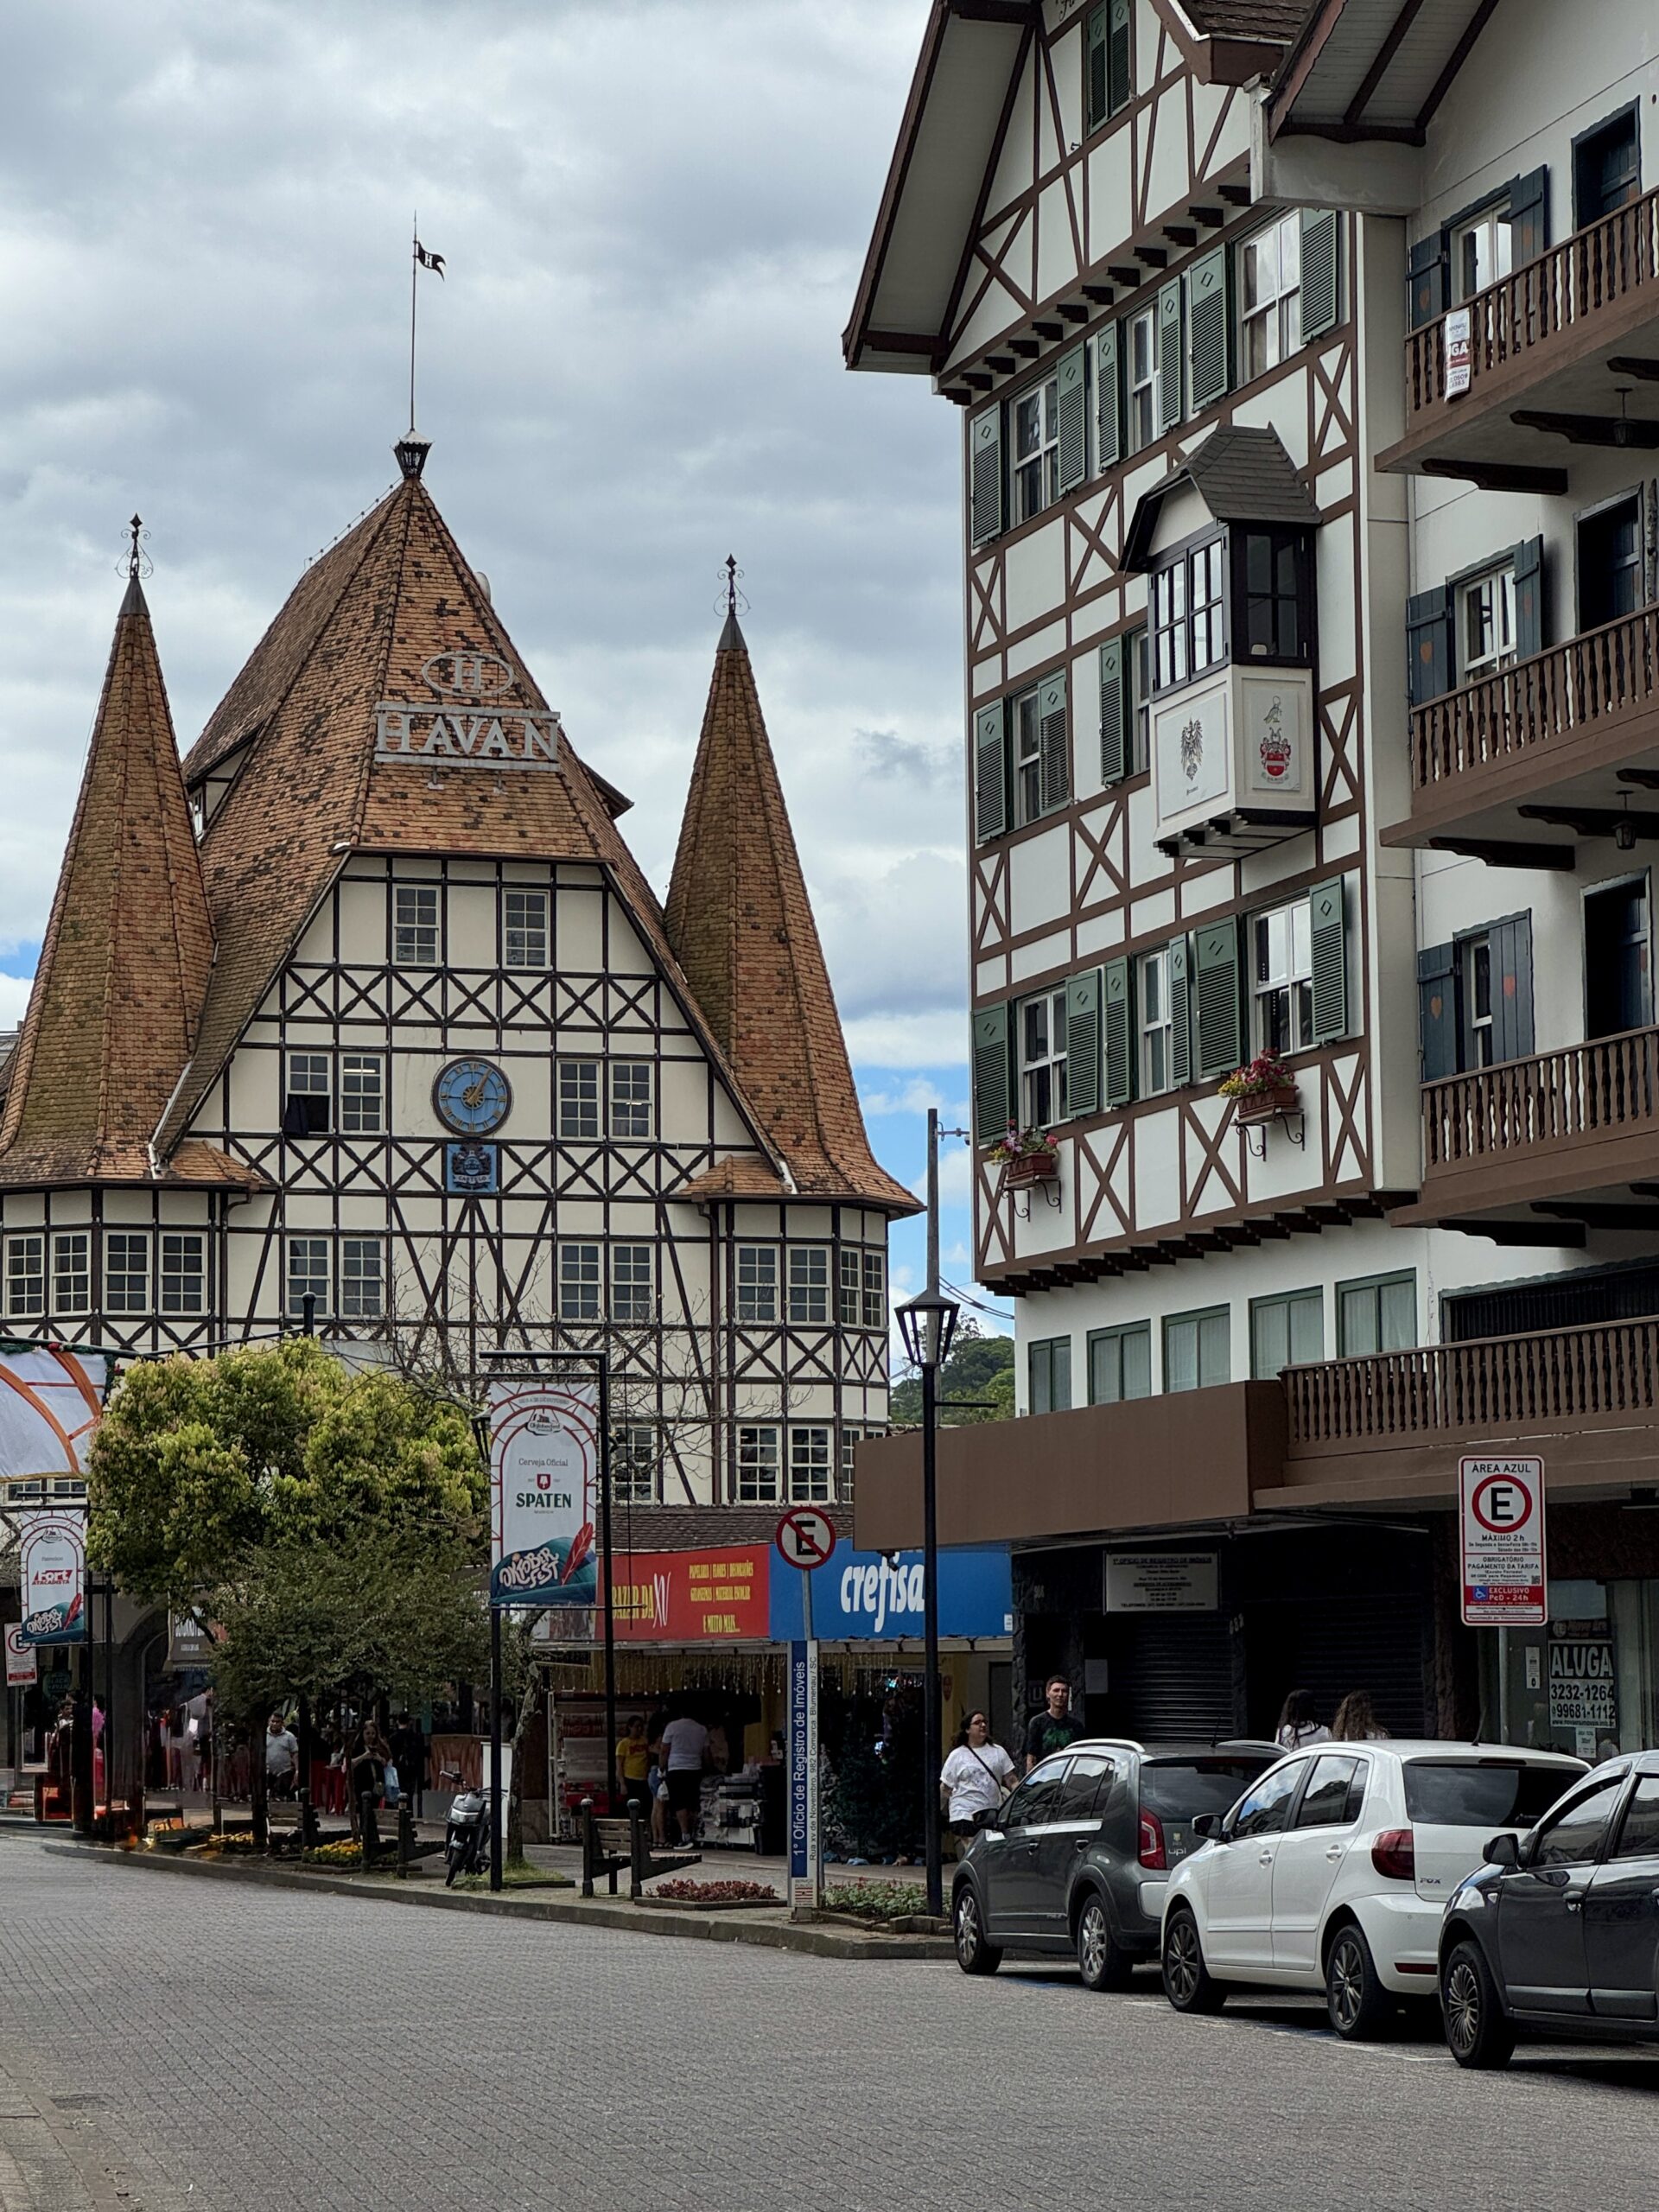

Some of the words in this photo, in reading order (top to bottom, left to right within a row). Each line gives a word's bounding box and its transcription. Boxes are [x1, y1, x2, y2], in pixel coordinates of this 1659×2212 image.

[424, 252, 433, 268] H
[453, 657, 486, 690] H
[375, 712, 560, 762] HAVAN
[518, 1458, 545, 1467] Cerveja
[1471, 1461, 1501, 1472] ÁREA
[1503, 1464, 1532, 1472] AZUL
[516, 1492, 572, 1508] SPATEN
[1491, 1487, 1514, 1521] E
[796, 1520, 817, 1555] E
[1482, 1532, 1511, 1541] MÁXIMO
[641, 1585, 655, 1618] DA
[652, 1572, 671, 1629] XV
[841, 1552, 925, 1633] crefisa
[810, 1656, 816, 1669] SC
[1551, 1646, 1614, 1677] ALUGA
[793, 1661, 804, 1707] Imóveis
[1551, 1684, 1615, 1701] 3232-1264
[793, 1712, 804, 1727] de
[793, 1730, 807, 1780] Registro
[792, 1785, 804, 1801] de
[810, 1821, 816, 1831] de
